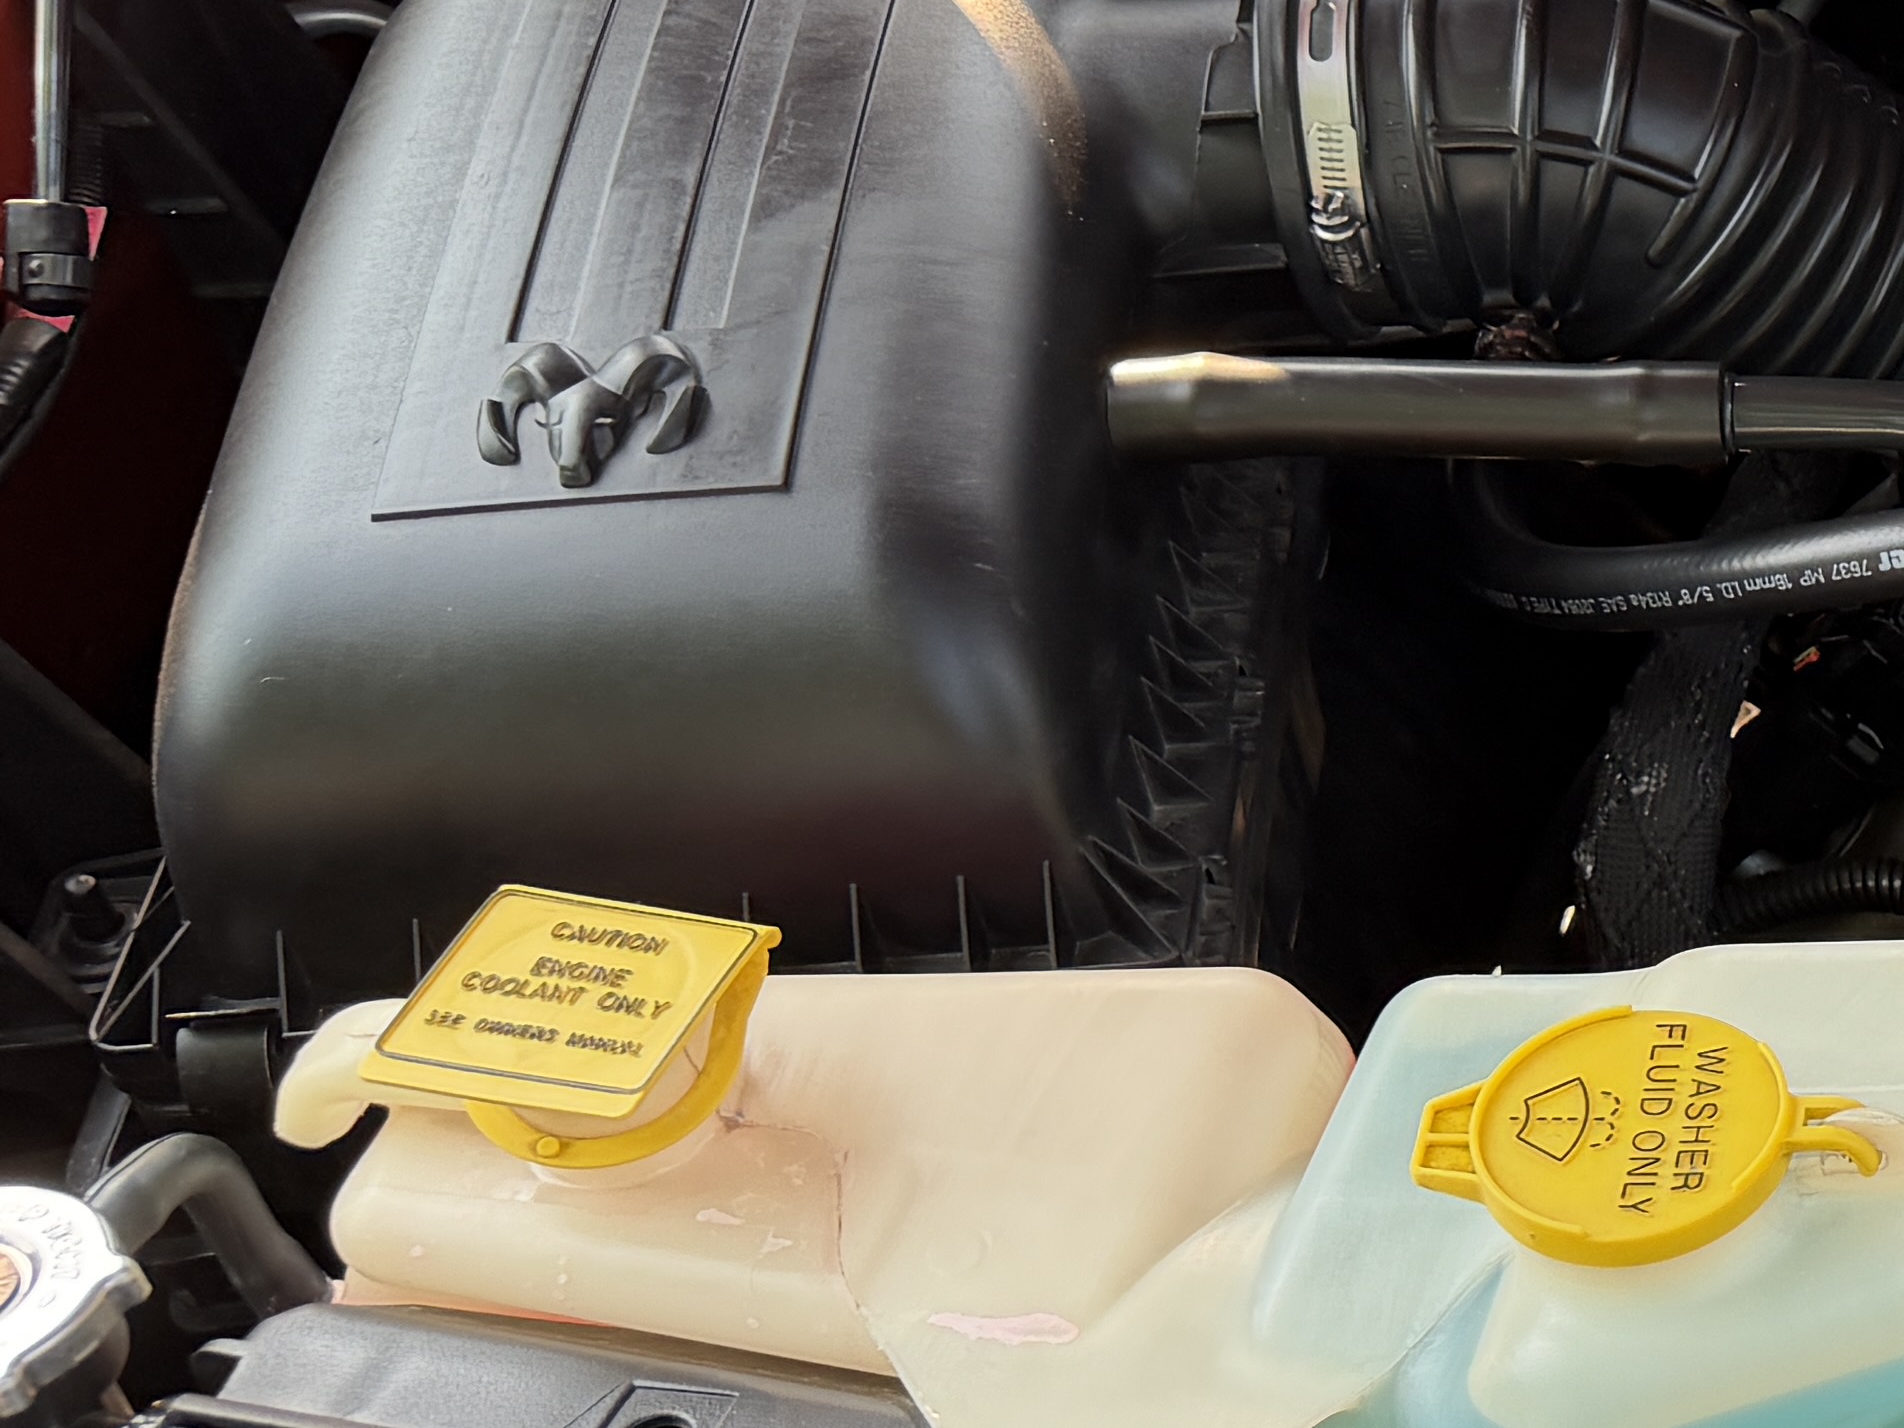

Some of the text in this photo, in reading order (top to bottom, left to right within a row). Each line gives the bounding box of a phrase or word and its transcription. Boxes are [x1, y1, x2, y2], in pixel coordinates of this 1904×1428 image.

[1743, 571, 1792, 594] 16mm
[1798, 566, 1824, 586] MP
[1830, 557, 1871, 581] 7637
[1597, 593, 1626, 613] SAE
[1630, 589, 1672, 610] R134a
[549, 921, 671, 956] CAUTION
[529, 955, 635, 990] ENGINE
[460, 971, 674, 1021] COOLANT ONLY
[1616, 1023, 1689, 1215] FLUID ONLY
[1669, 1045, 1729, 1194] WASHER
